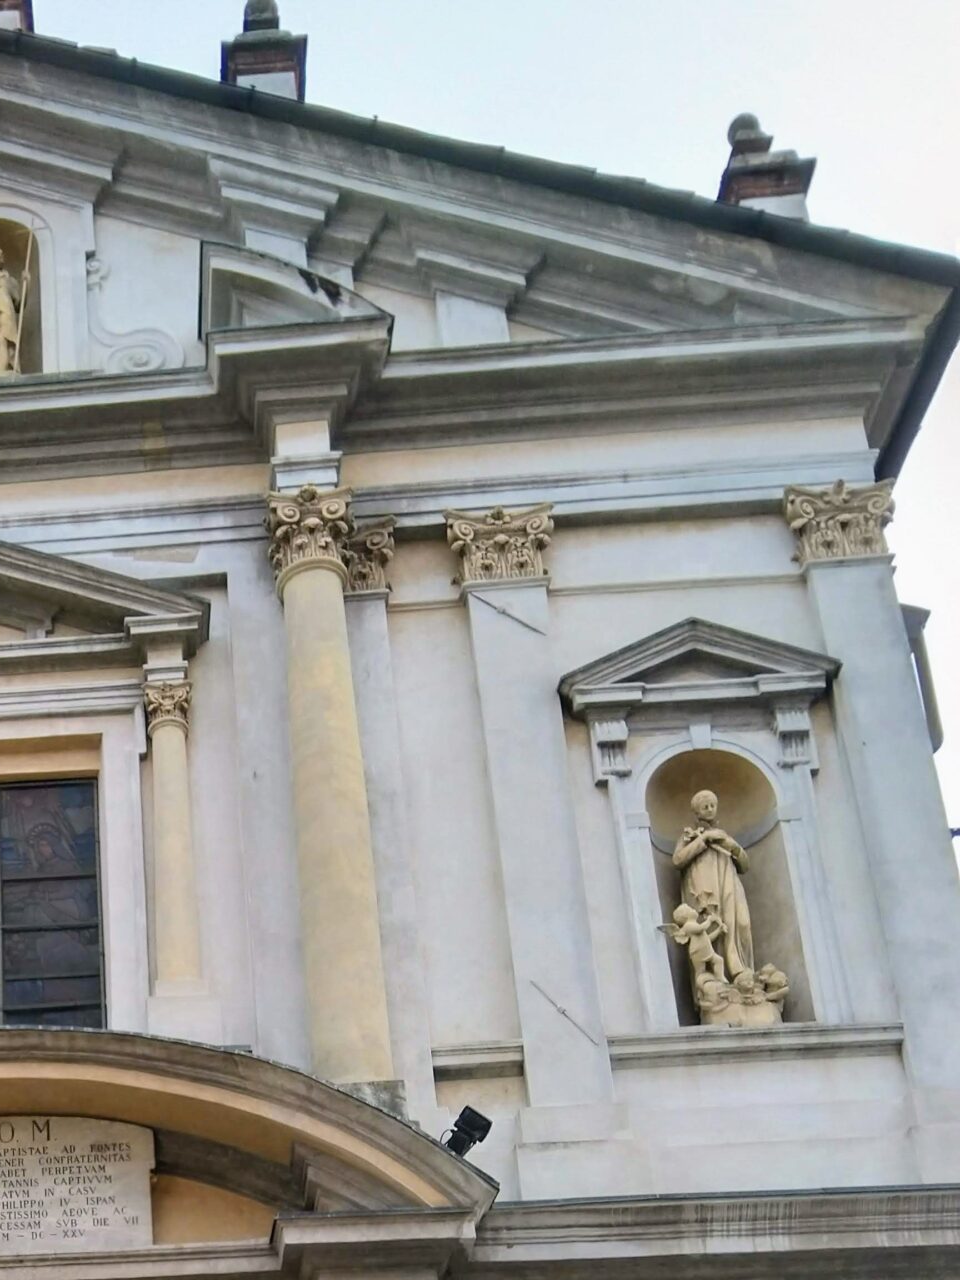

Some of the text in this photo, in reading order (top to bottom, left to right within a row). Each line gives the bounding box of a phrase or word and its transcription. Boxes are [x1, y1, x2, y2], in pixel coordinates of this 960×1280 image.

[62, 1144, 76, 1154] AD
[38, 1153, 132, 1166] CONFRATERNITAS
[41, 1164, 106, 1176] PERPETVAM
[53, 1175, 113, 1187] CAPTIVVM
[44, 1187, 55, 1197] IN
[68, 1186, 97, 1196] CASV
[59, 1198, 71, 1207] IV
[86, 1195, 116, 1206] ISPAN
[113, 1206, 128, 1216] AC
[56, 1218, 78, 1229] SVB
[92, 1217, 110, 1227] DIE
[123, 1216, 139, 1225] VII
[2, 1232, 10, 1241] M
[31, 1231, 45, 1241] DC
[62, 1229, 86, 1239] XXV
